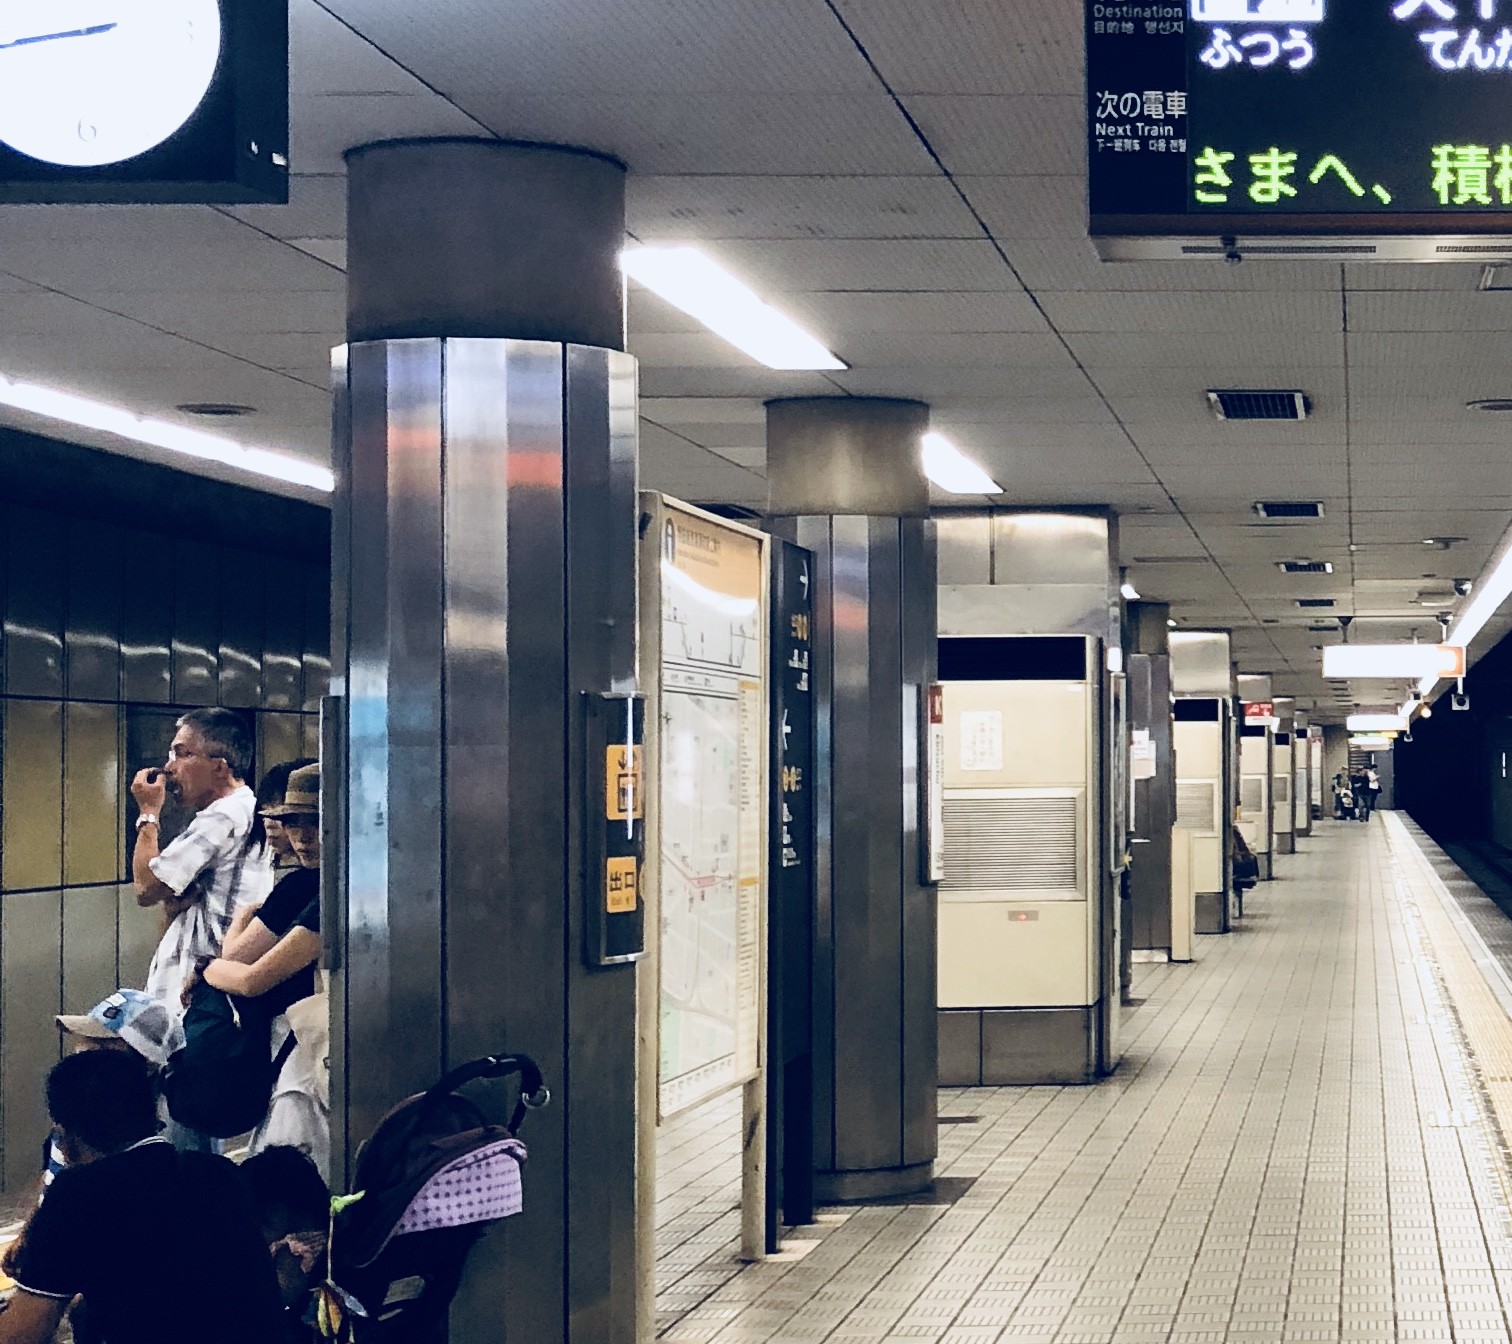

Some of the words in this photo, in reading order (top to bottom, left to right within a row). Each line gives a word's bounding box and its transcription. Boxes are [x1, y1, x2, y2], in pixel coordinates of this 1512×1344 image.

[1094, 3, 1183, 18] Destination
[1199, 27, 1314, 70] ふつう
[1095, 90, 1188, 120] 次の電車
[1095, 122, 1132, 136] Next
[1135, 122, 1174, 136] Train
